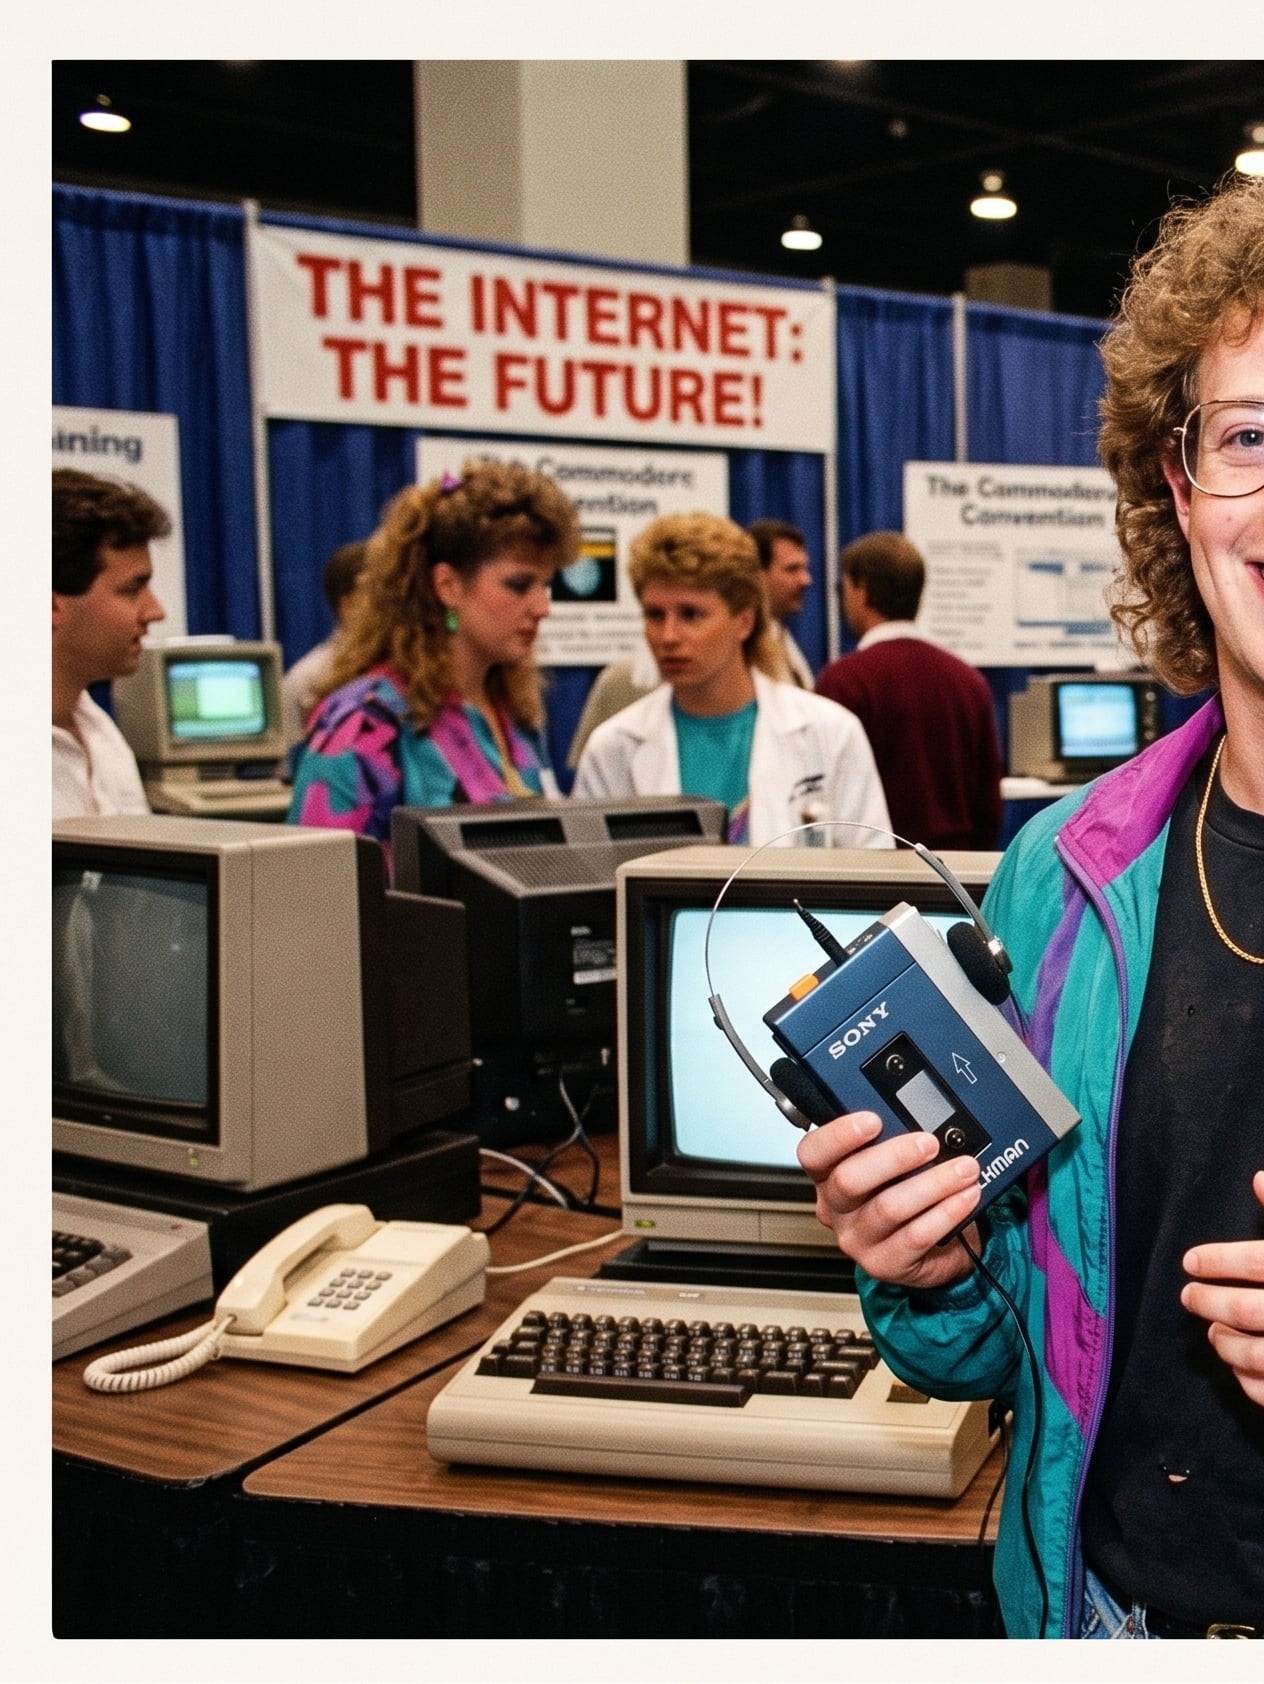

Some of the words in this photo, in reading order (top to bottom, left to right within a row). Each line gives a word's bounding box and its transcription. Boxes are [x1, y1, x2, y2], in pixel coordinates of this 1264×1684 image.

[297, 253, 444, 330] THE
[471, 274, 803, 363] INTERNET:
[322, 336, 469, 408] THE
[496, 352, 763, 428] FUTURE!
[52, 426, 142, 464] ining
[574, 493, 659, 516] ention
[927, 475, 969, 498] The
[960, 503, 1106, 527] Convention
[828, 1000, 889, 1060] SONY
[978, 1138, 1030, 1190] LKMAN
